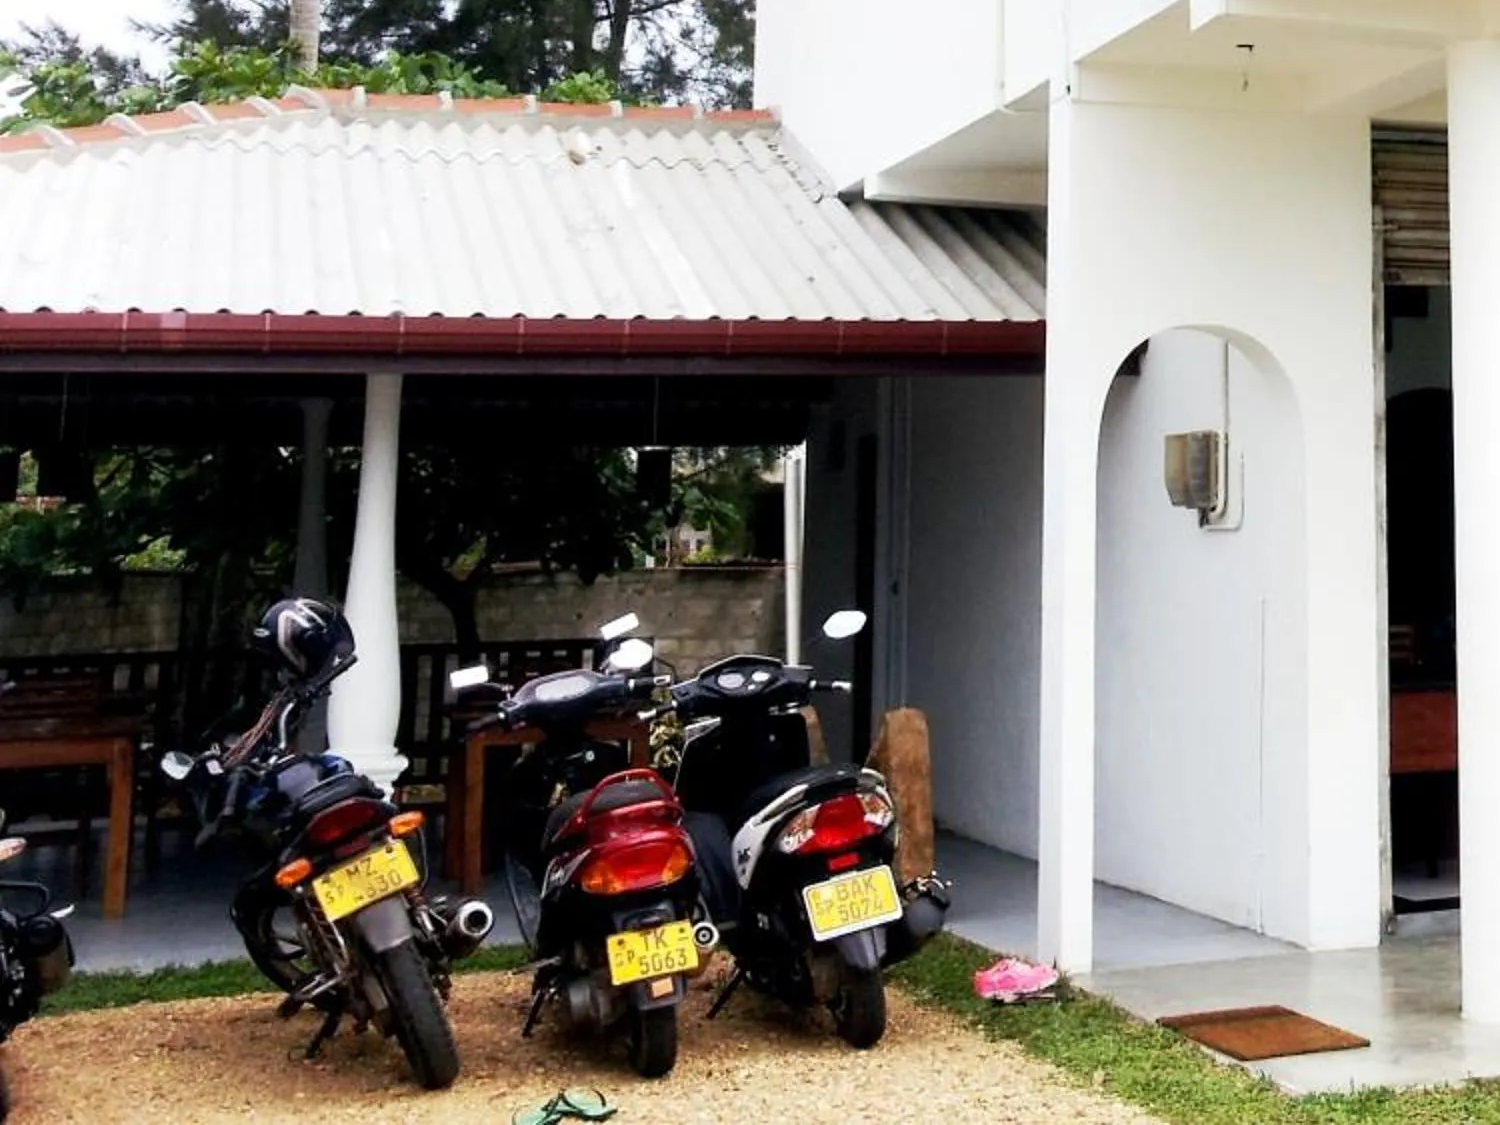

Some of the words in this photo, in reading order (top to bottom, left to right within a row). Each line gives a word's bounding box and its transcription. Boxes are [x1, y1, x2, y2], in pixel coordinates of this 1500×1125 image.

[835, 874, 877, 902] BAK
[639, 928, 669, 951] TK
[639, 948, 688, 975] 5063
